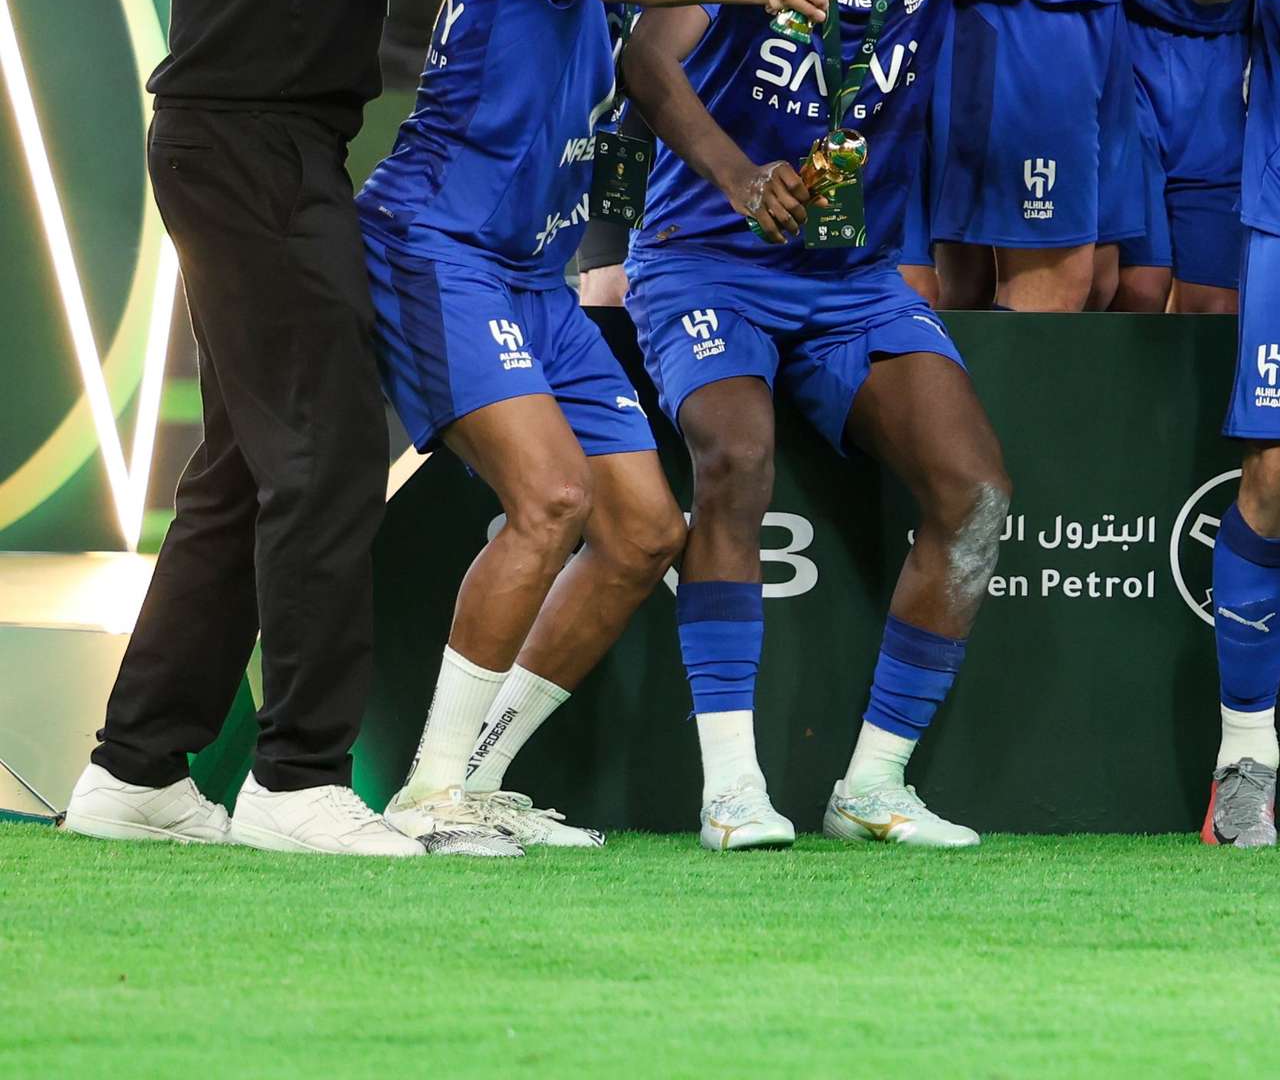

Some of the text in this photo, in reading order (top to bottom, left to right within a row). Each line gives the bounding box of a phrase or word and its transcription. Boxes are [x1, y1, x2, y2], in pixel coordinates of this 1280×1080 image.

[752, 86, 831, 119] GAME
[1023, 200, 1054, 210] ALHILAL
[1038, 514, 1157, 552] البترول
[1041, 569, 1157, 599] Petrol
[468, 707, 519, 767] TAPEDESIGN
